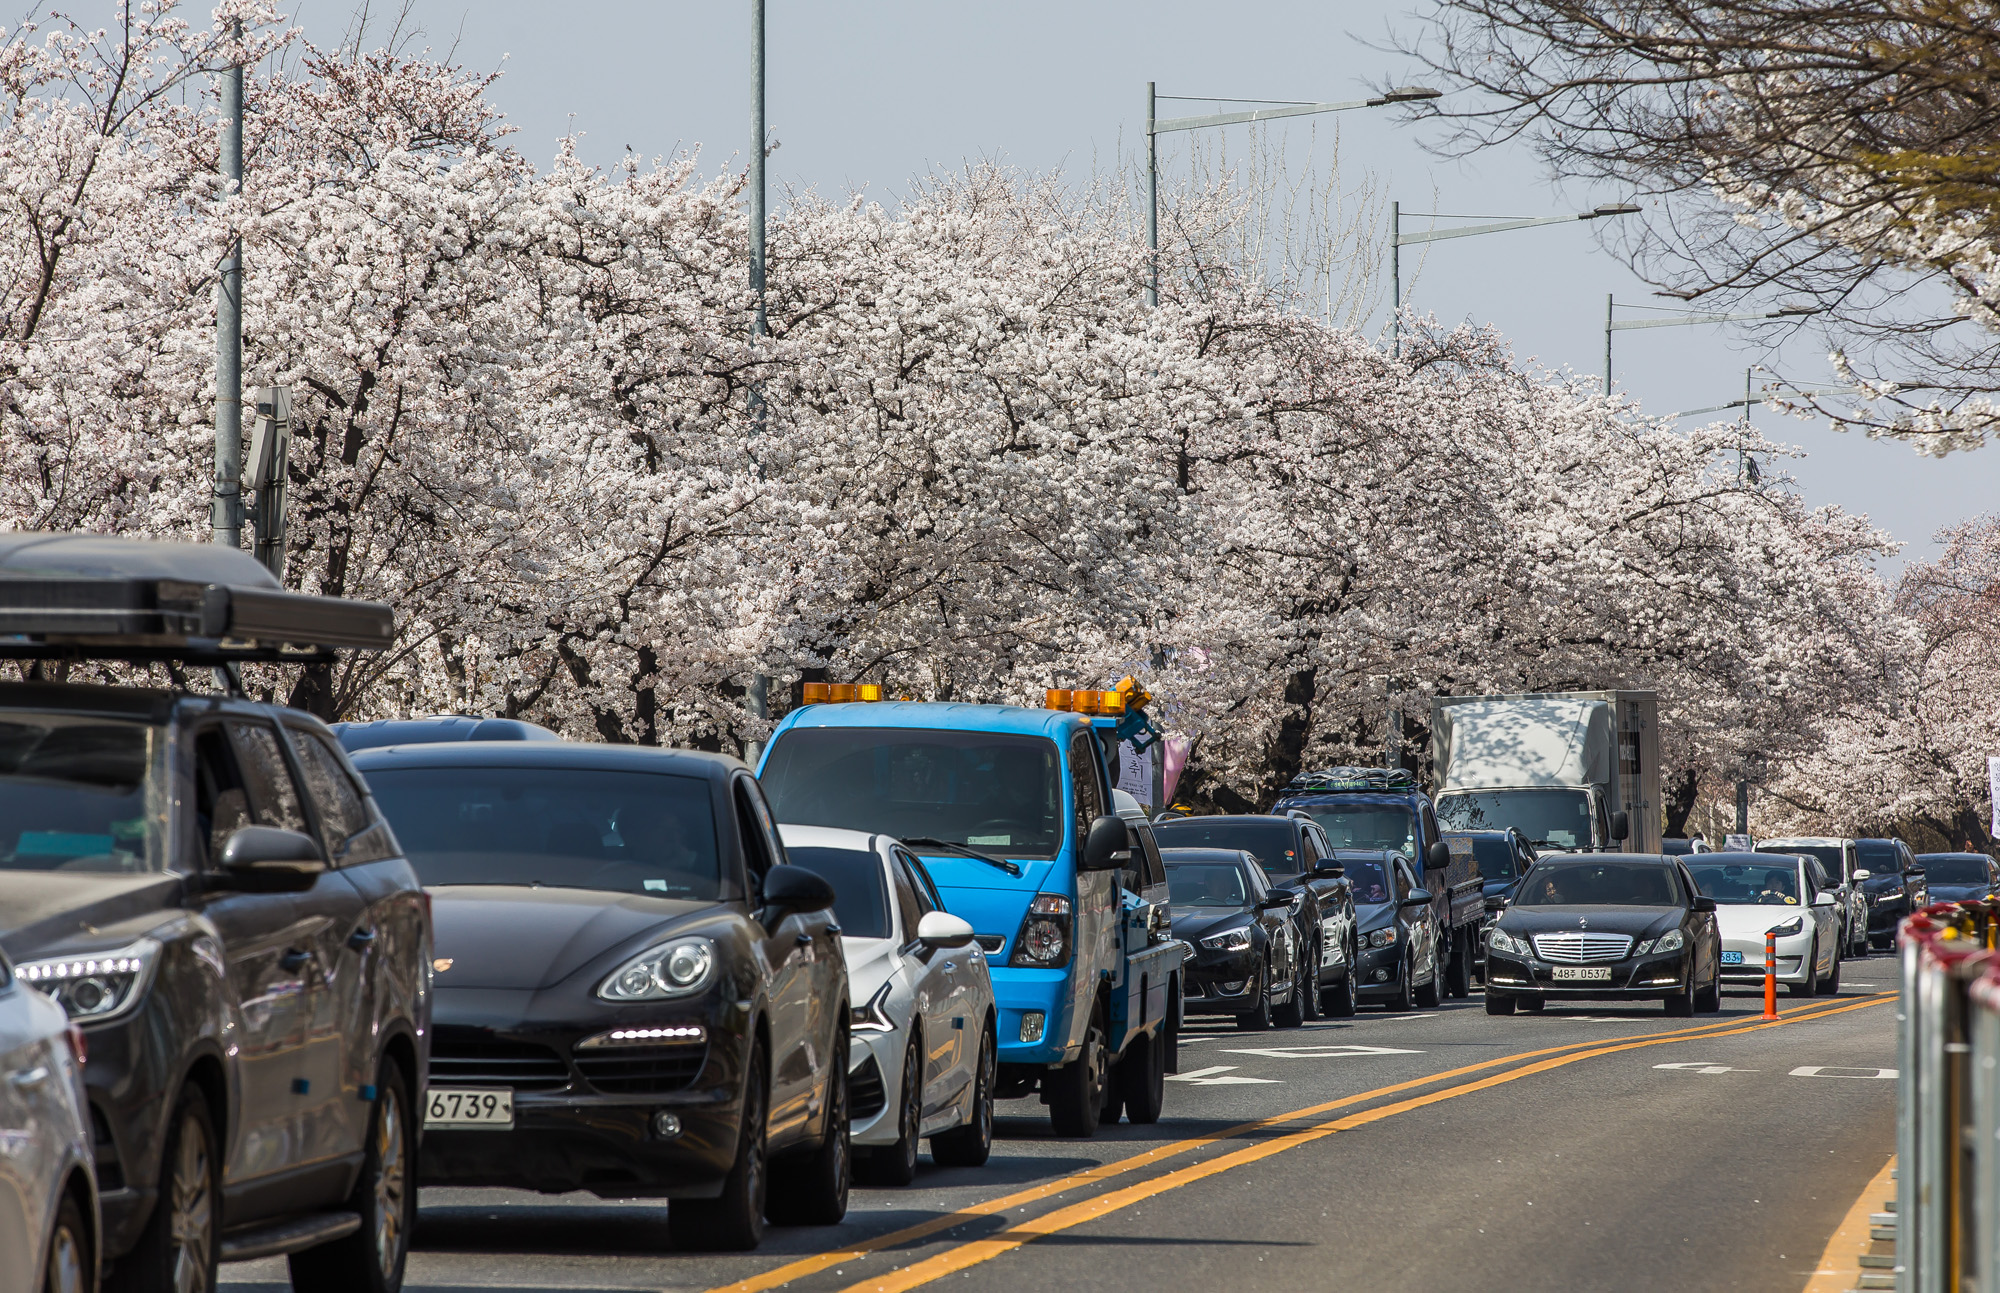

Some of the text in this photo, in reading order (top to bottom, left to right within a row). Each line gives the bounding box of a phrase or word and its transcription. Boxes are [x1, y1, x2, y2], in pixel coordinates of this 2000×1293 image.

[1557, 968, 1607, 979] 48주 0537
[430, 1093, 498, 1119] 6739
